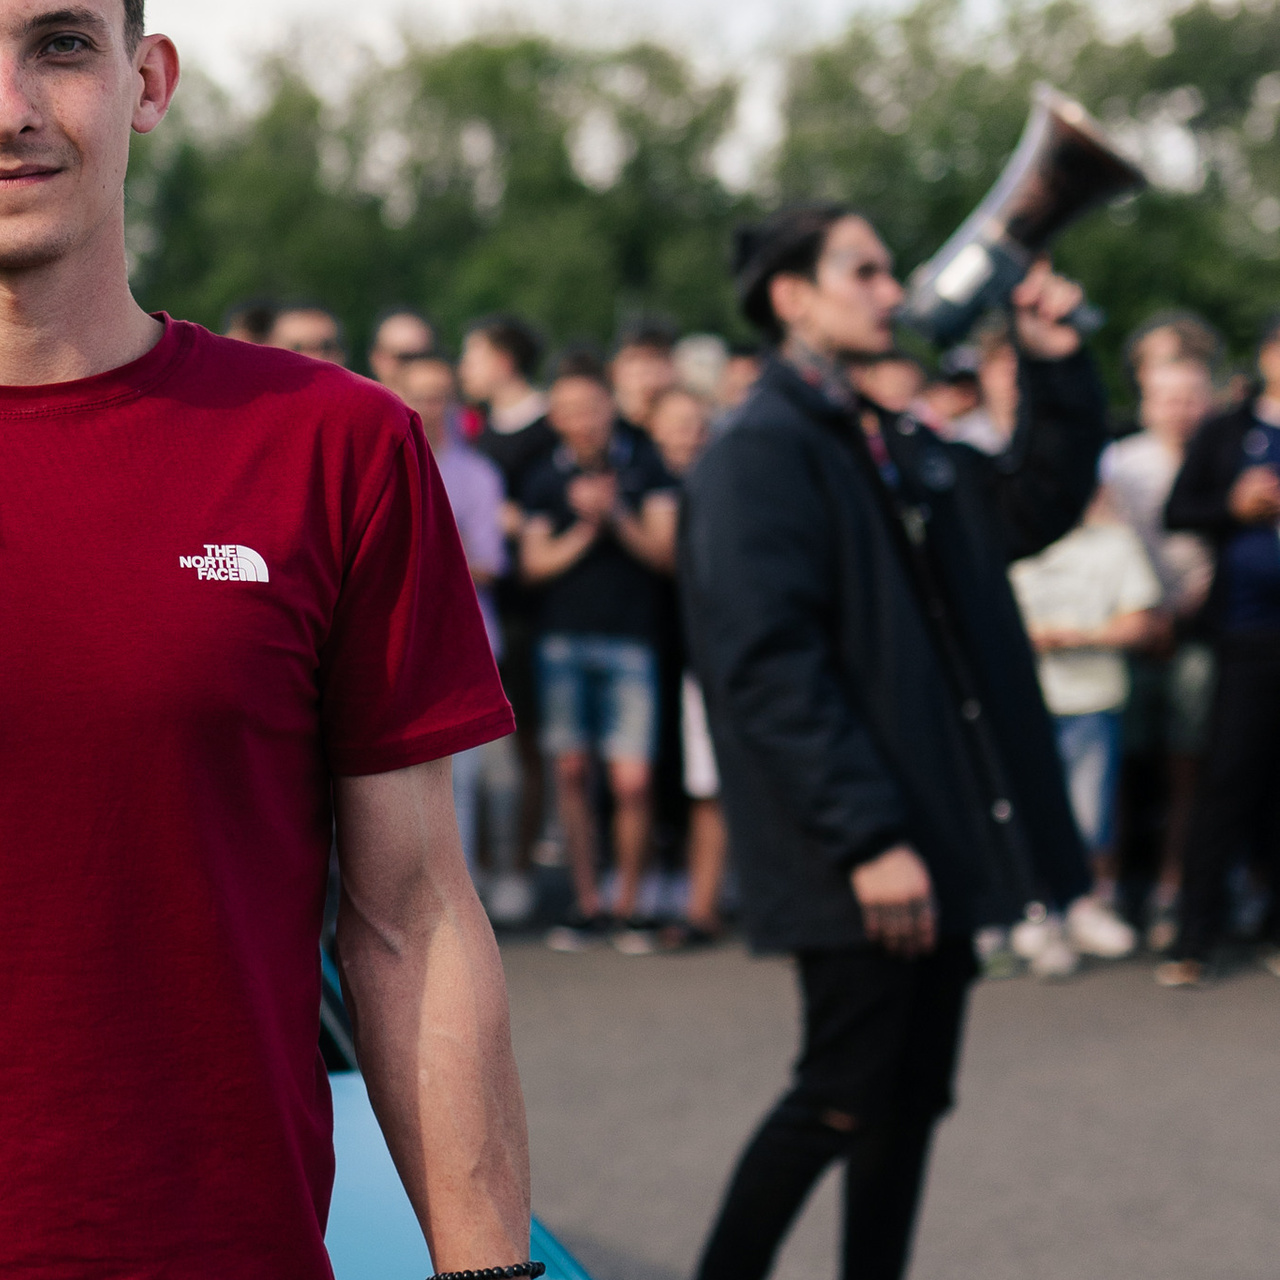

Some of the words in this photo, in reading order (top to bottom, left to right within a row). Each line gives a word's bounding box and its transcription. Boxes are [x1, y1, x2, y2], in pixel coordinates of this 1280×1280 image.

[203, 544, 236, 558] THE
[178, 556, 238, 569] NORTH
[197, 568, 240, 581] FACE
